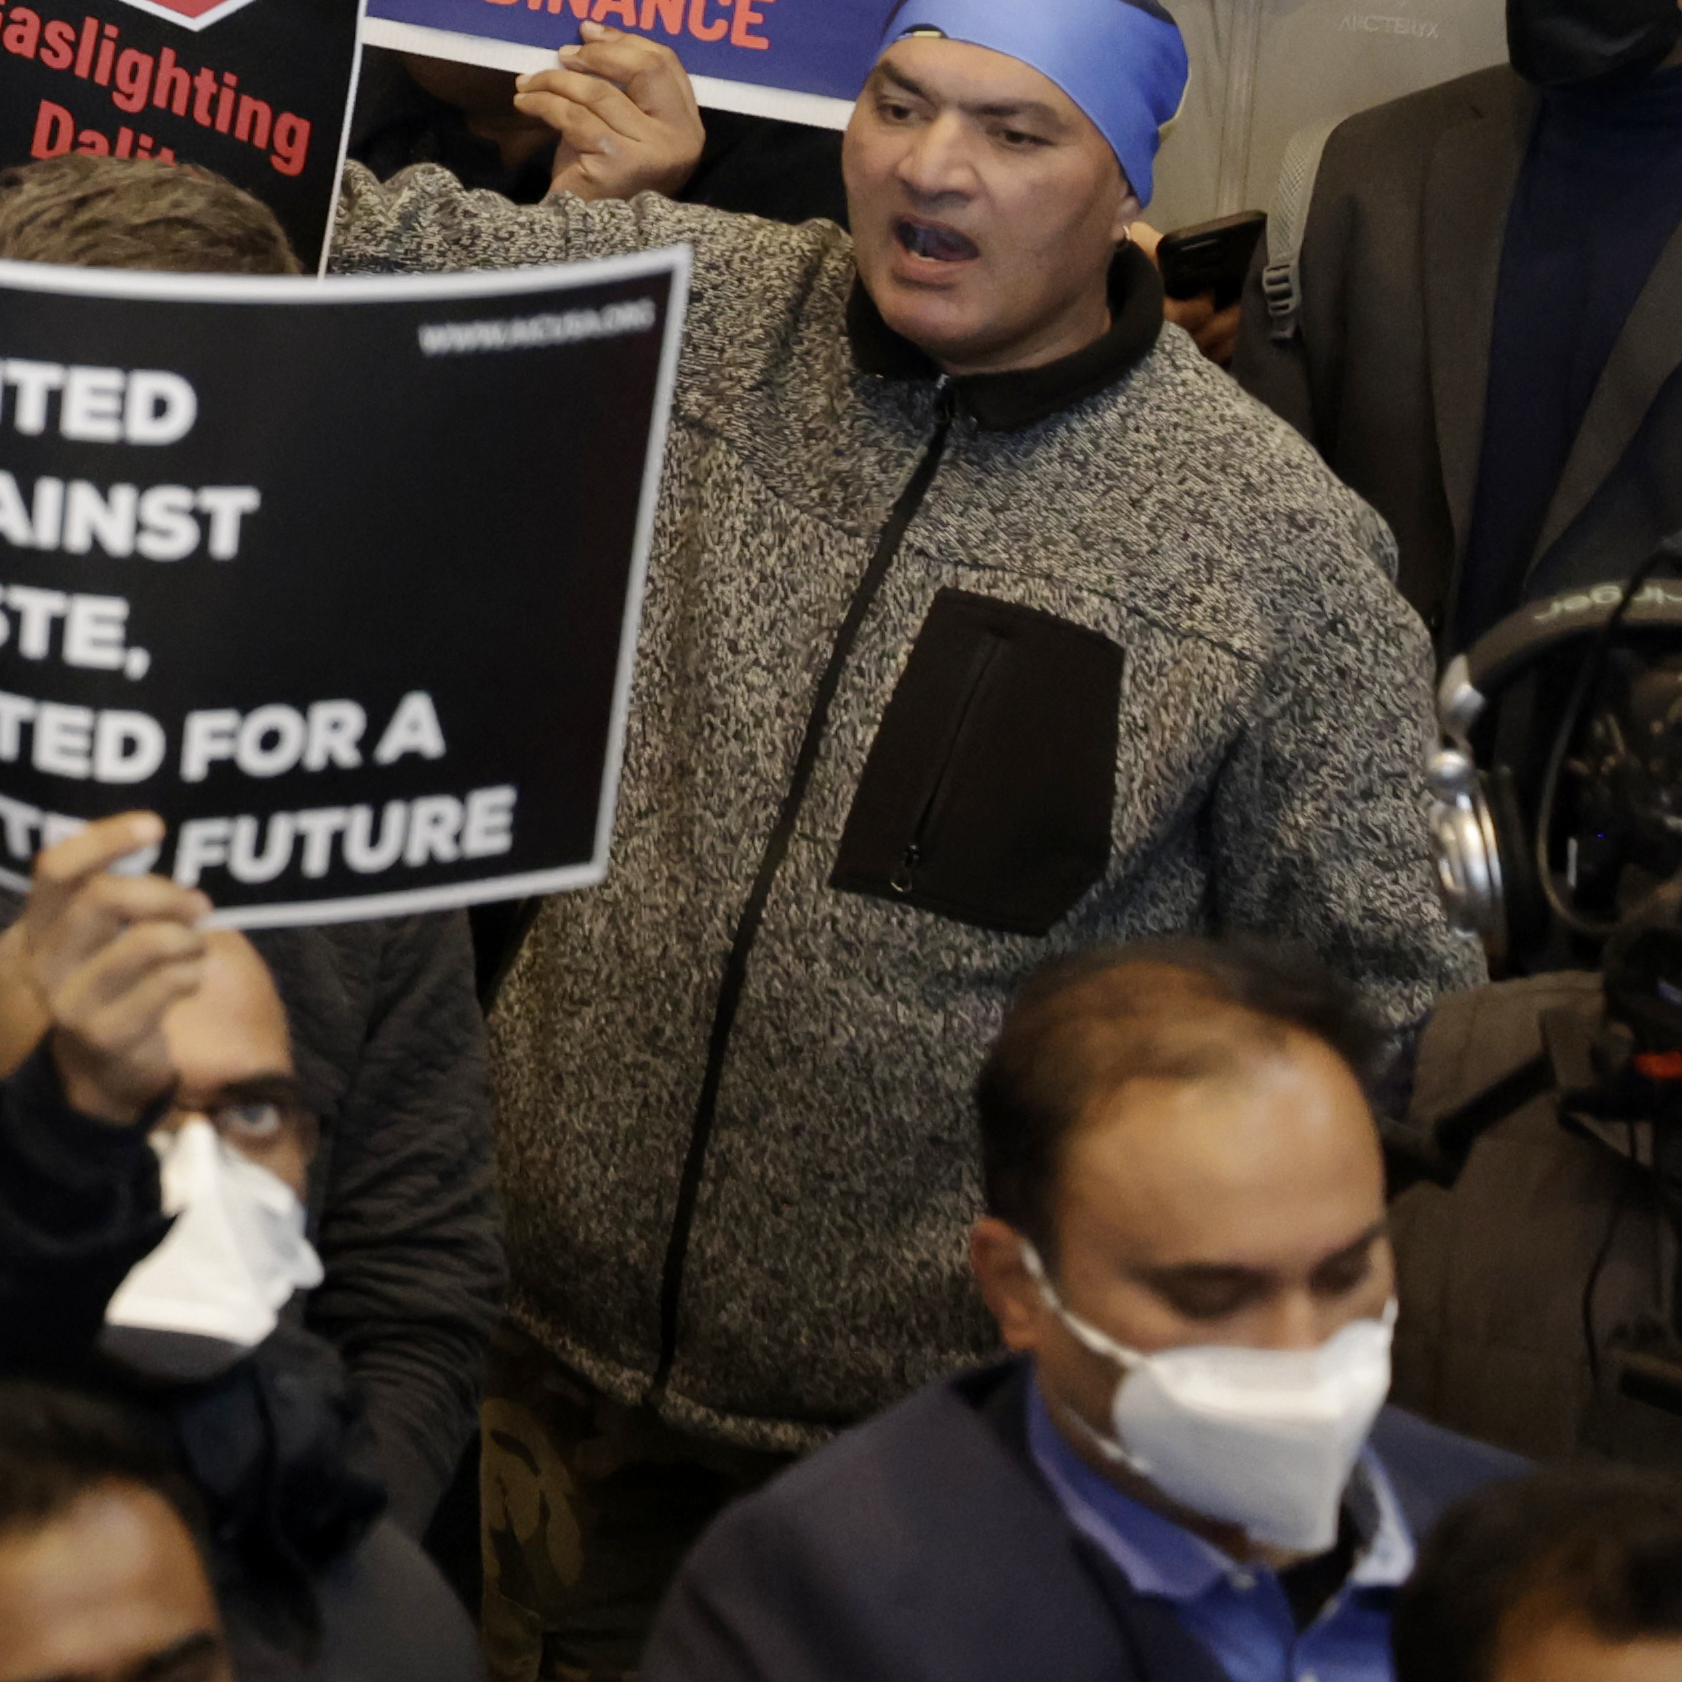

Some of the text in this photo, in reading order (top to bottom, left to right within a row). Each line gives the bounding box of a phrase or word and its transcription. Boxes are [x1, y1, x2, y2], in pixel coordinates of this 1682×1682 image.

[181, 698, 363, 783] FOR
[373, 690, 445, 764] A
[172, 787, 519, 889] FUTURE
